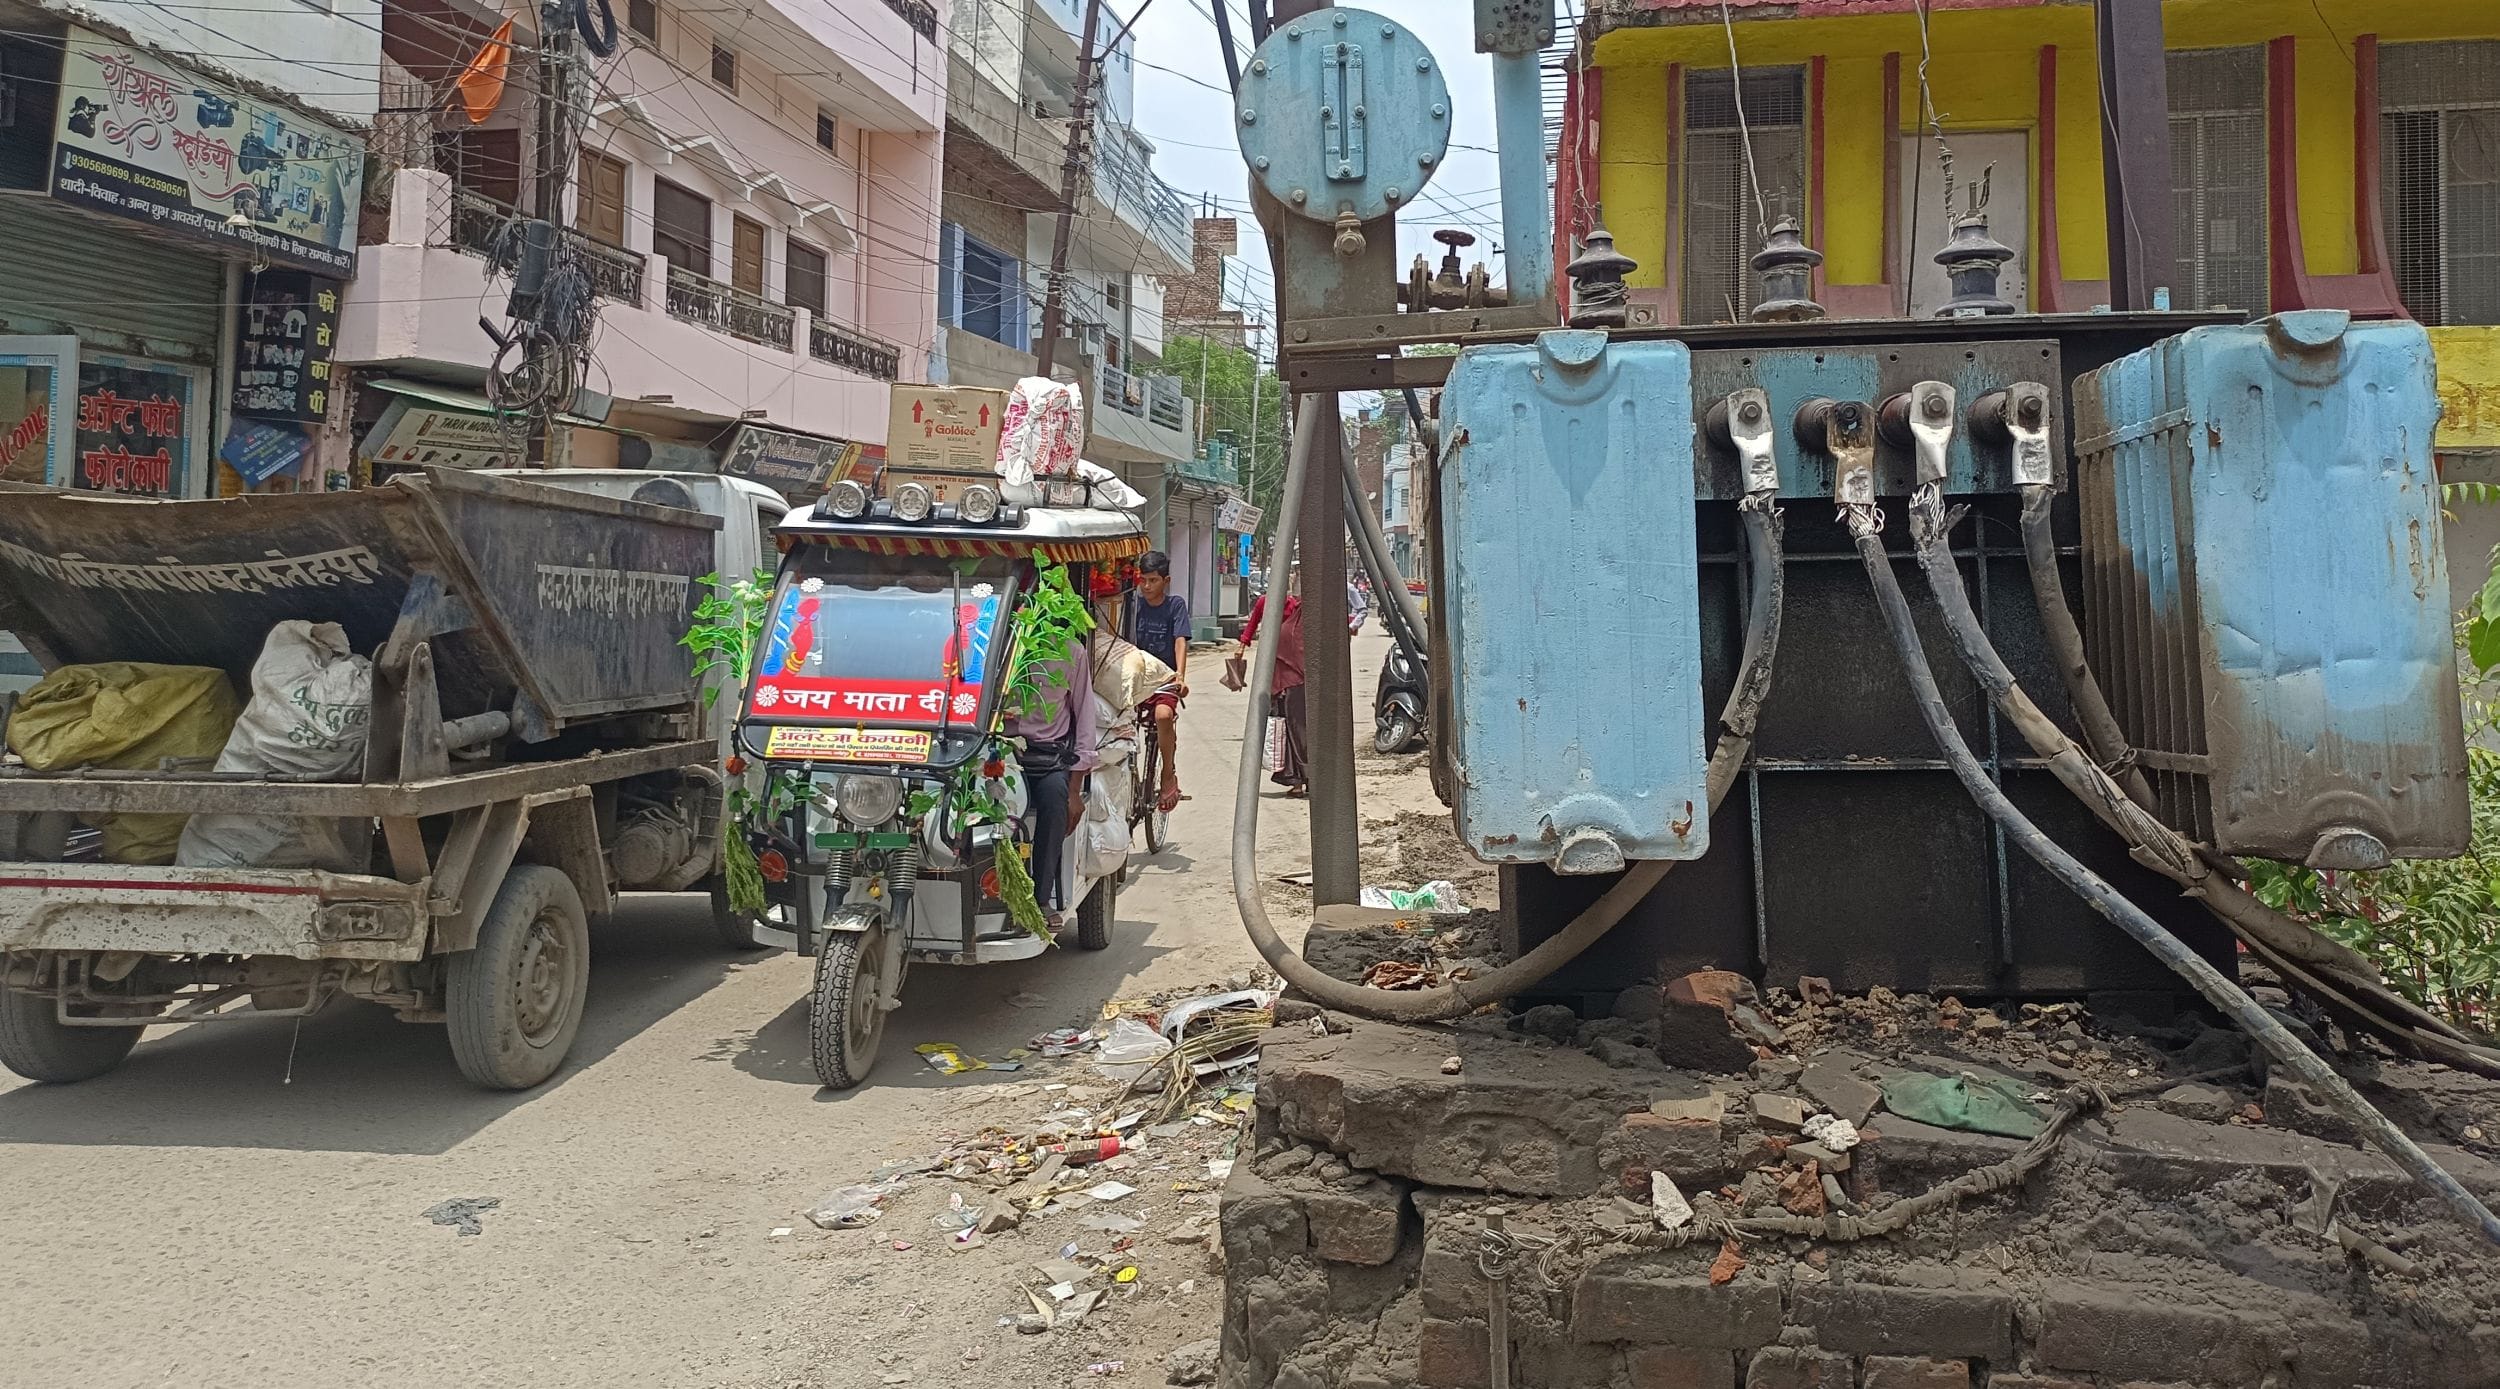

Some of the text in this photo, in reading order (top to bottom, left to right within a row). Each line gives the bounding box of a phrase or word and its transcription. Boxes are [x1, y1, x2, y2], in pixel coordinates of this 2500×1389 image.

[71, 154, 188, 198] 9305689699, 8423590501
[127, 197, 151, 212] अन्य
[151, 204, 170, 220] शुभ
[171, 210, 203, 227] अवसरों
[217, 222, 237, 238] H.D.
[280, 239, 290, 252] के
[291, 241, 307, 258] लिए
[140, 393, 182, 439] फोटो
[441, 417, 469, 431] TARIK
[935, 424, 977, 436] Goldiee
[247, 545, 382, 588] फतेहपुर
[782, 688, 953, 714] जय माता दी
[858, 733, 928, 746] कम्पनी
